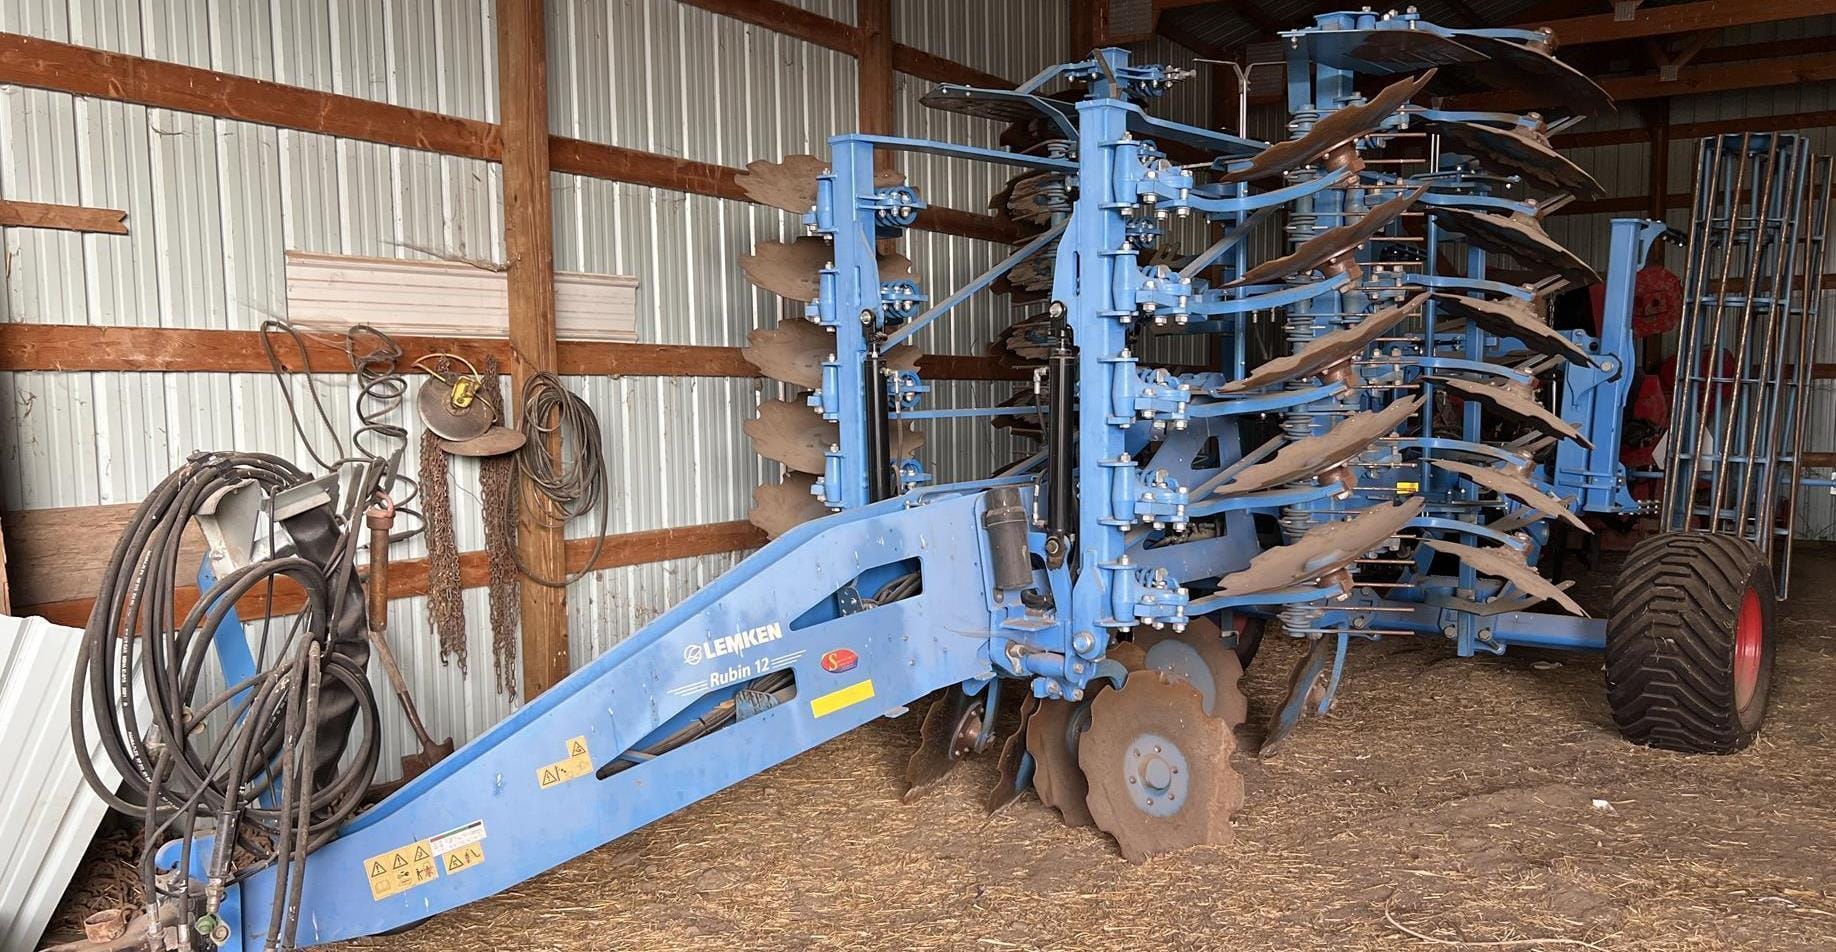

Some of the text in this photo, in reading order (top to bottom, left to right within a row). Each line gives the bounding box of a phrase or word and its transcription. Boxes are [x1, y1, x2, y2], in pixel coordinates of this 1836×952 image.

[703, 622, 782, 659] LEMKEN
[710, 657, 770, 688] Rubin 12
